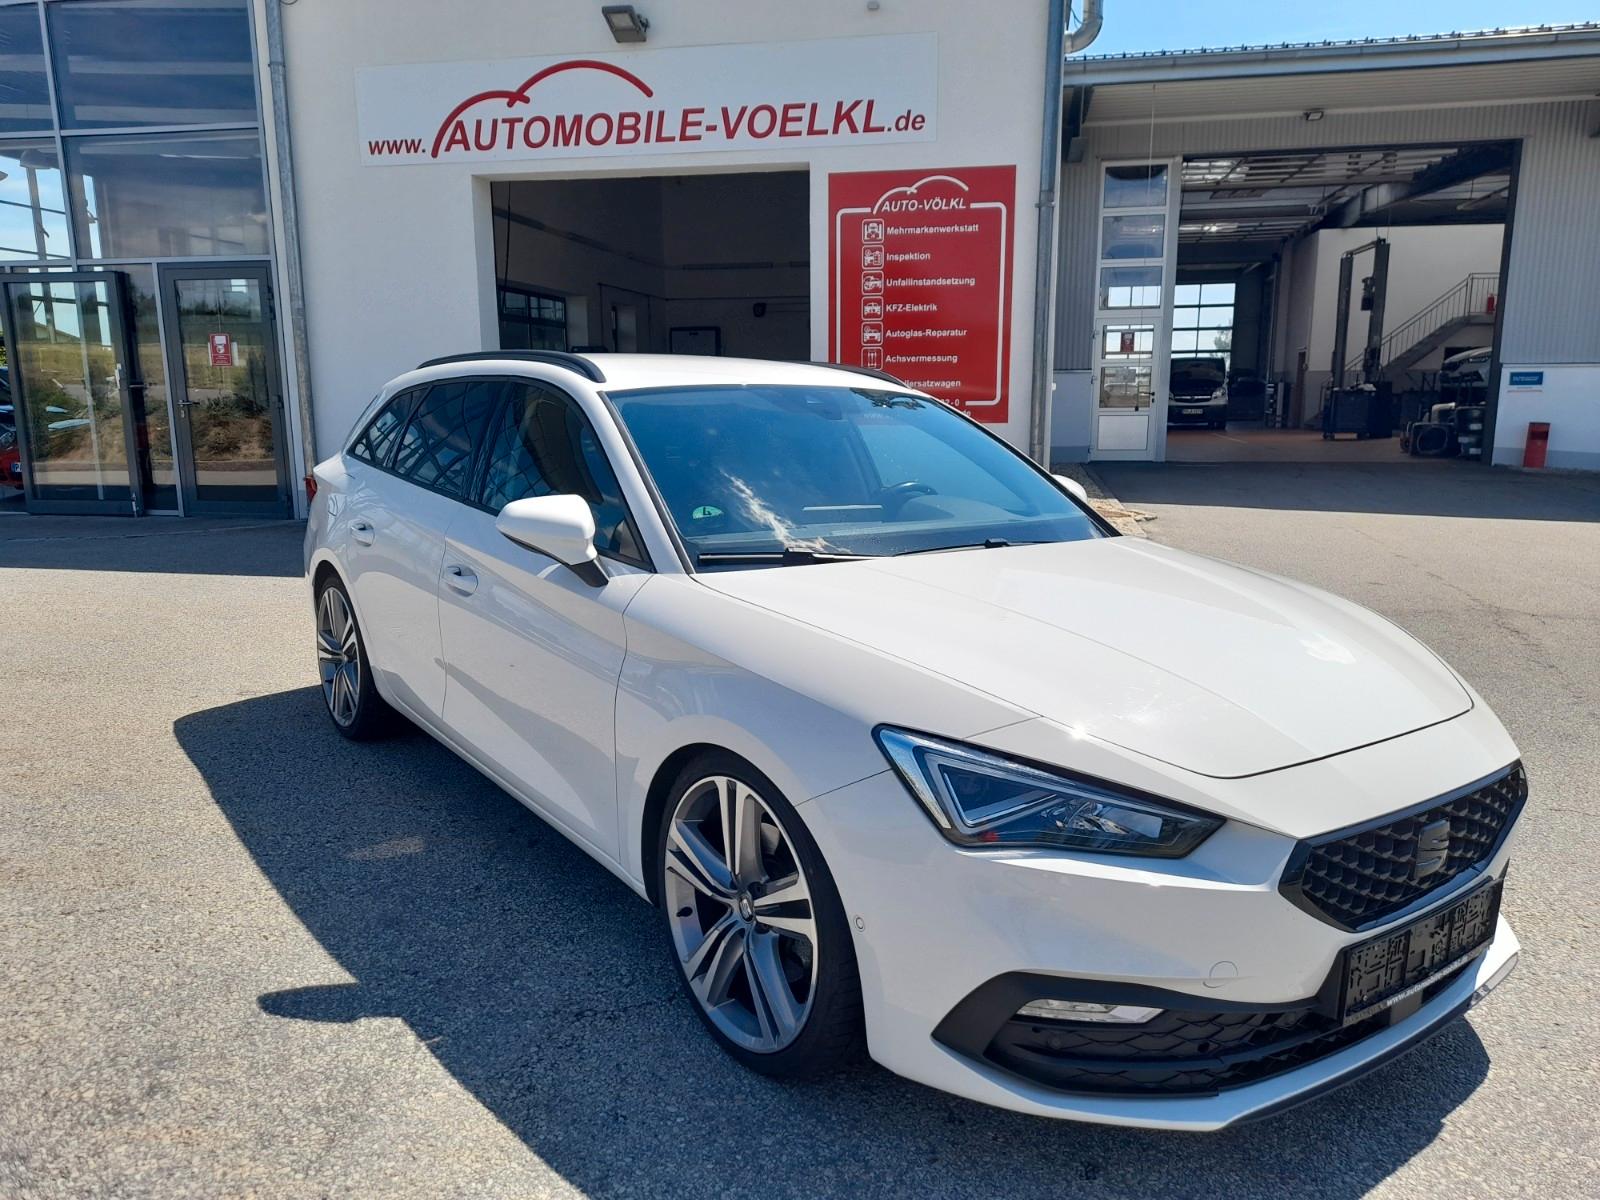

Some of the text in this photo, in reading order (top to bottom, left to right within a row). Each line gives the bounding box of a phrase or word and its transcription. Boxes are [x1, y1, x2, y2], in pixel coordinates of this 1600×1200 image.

[881, 197, 967, 212] AUTO-VÖLKL
[886, 224, 979, 235] Mehrmarkenwerkstatt
[886, 252, 931, 262] Inspektion
[886, 277, 976, 287] Unfallinstandsetzung
[885, 303, 938, 312] KFZ-Elektrik
[885, 328, 968, 339] Autoglas-Reparatur
[885, 354, 959, 364] Achsvermessung
[904, 380, 961, 389] llersatzwagen
